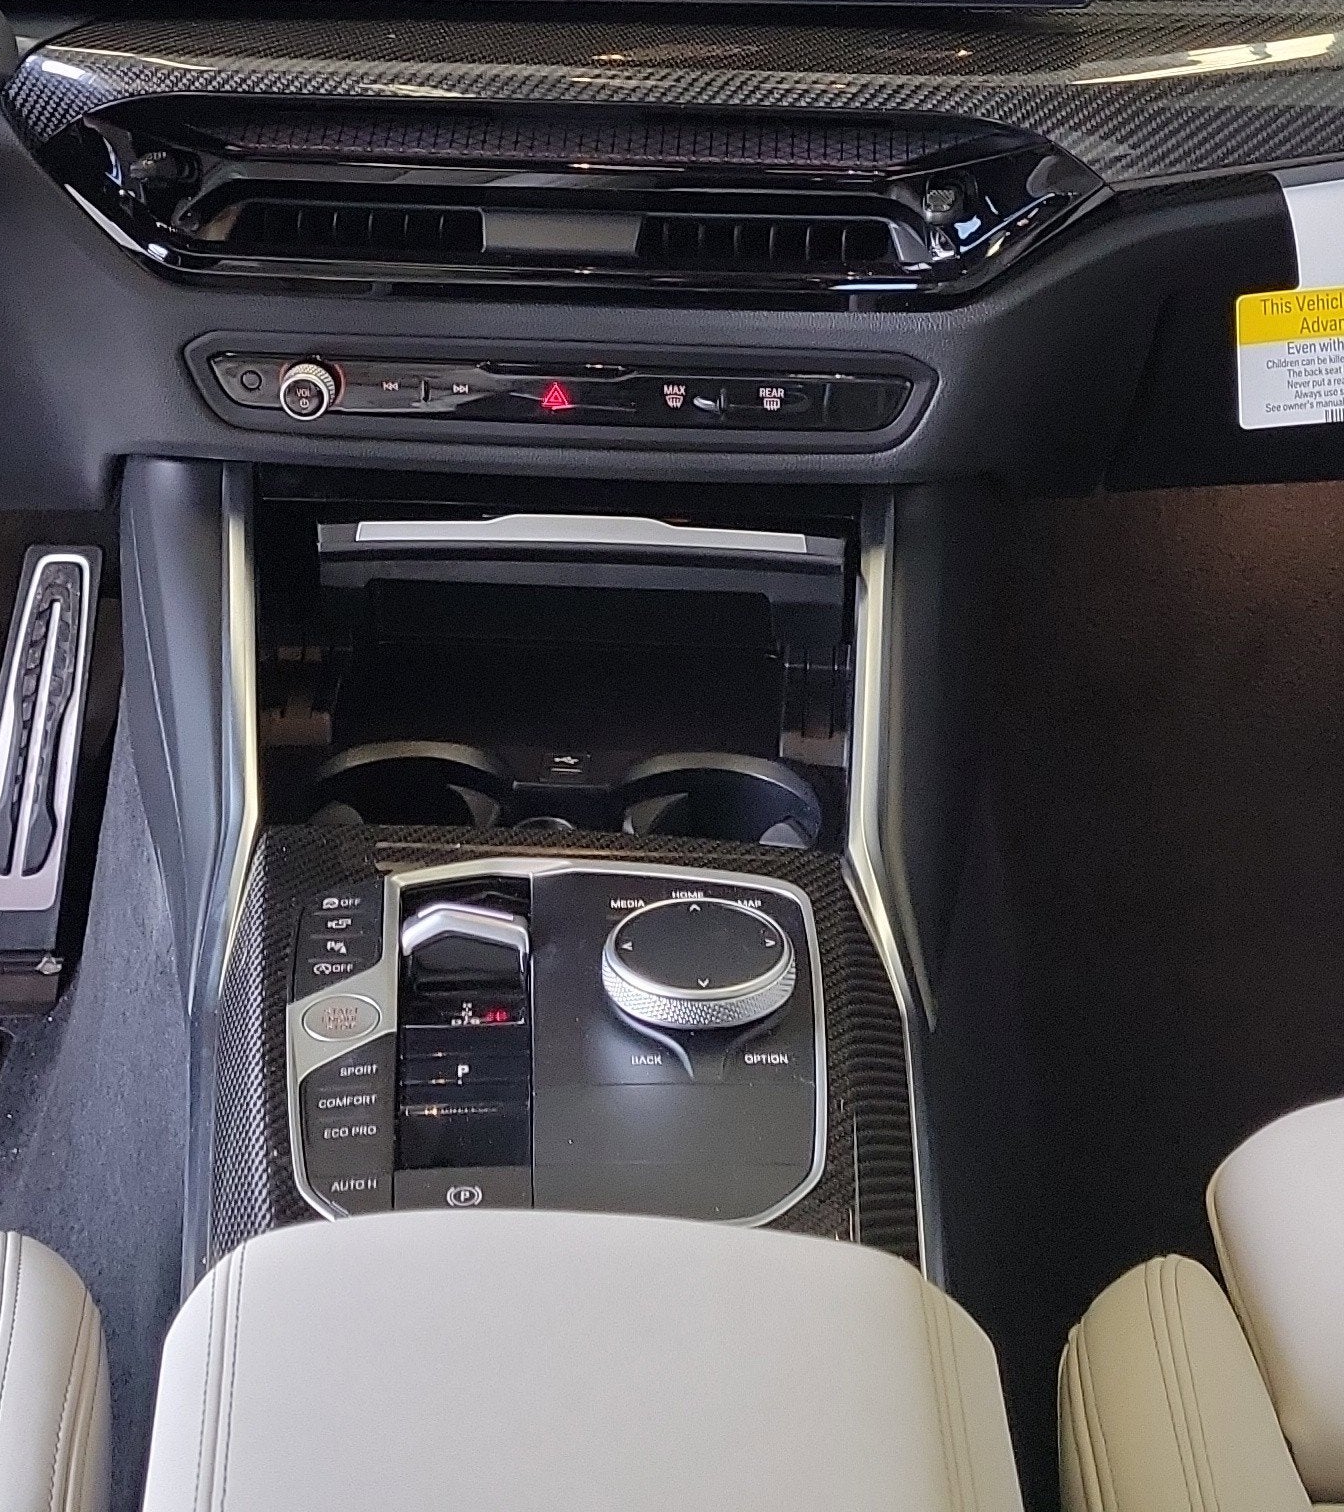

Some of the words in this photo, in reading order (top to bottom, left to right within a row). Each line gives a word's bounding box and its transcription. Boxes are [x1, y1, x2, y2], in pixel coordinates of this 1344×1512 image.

[1261, 296, 1292, 316] This
[1287, 339, 1316, 355] Even
[1319, 337, 1344, 353] with
[1266, 357, 1299, 369] Children
[1301, 358, 1316, 367] can
[1317, 355, 1328, 365] be
[1287, 368, 1302, 379] The
[1304, 366, 1322, 377] back
[1324, 364, 1342, 376] seat
[1287, 378, 1311, 389] Never
[1312, 377, 1325, 389] put
[296, 388, 311, 397] VOL
[663, 384, 686, 395] MAX
[759, 387, 785, 398] REAR
[1294, 388, 1322, 401] Always
[1323, 389, 1337, 397] use
[1265, 403, 1281, 413] See
[1282, 400, 1314, 412] owner's
[1315, 398, 1344, 409] manual
[671, 890, 705, 899] HOME
[340, 898, 362, 907] OFF
[610, 899, 646, 909] MEDIA
[332, 963, 354, 973] OFF
[631, 1055, 663, 1066] BACK
[744, 1053, 790, 1065] OPTION
[340, 1064, 377, 1077] SPORT
[318, 1094, 377, 1109] COMFORT
[323, 1127, 349, 1140] ECO
[351, 1125, 377, 1137] PRO
[331, 1178, 365, 1193] AUTO
[367, 1178, 377, 1190] H
